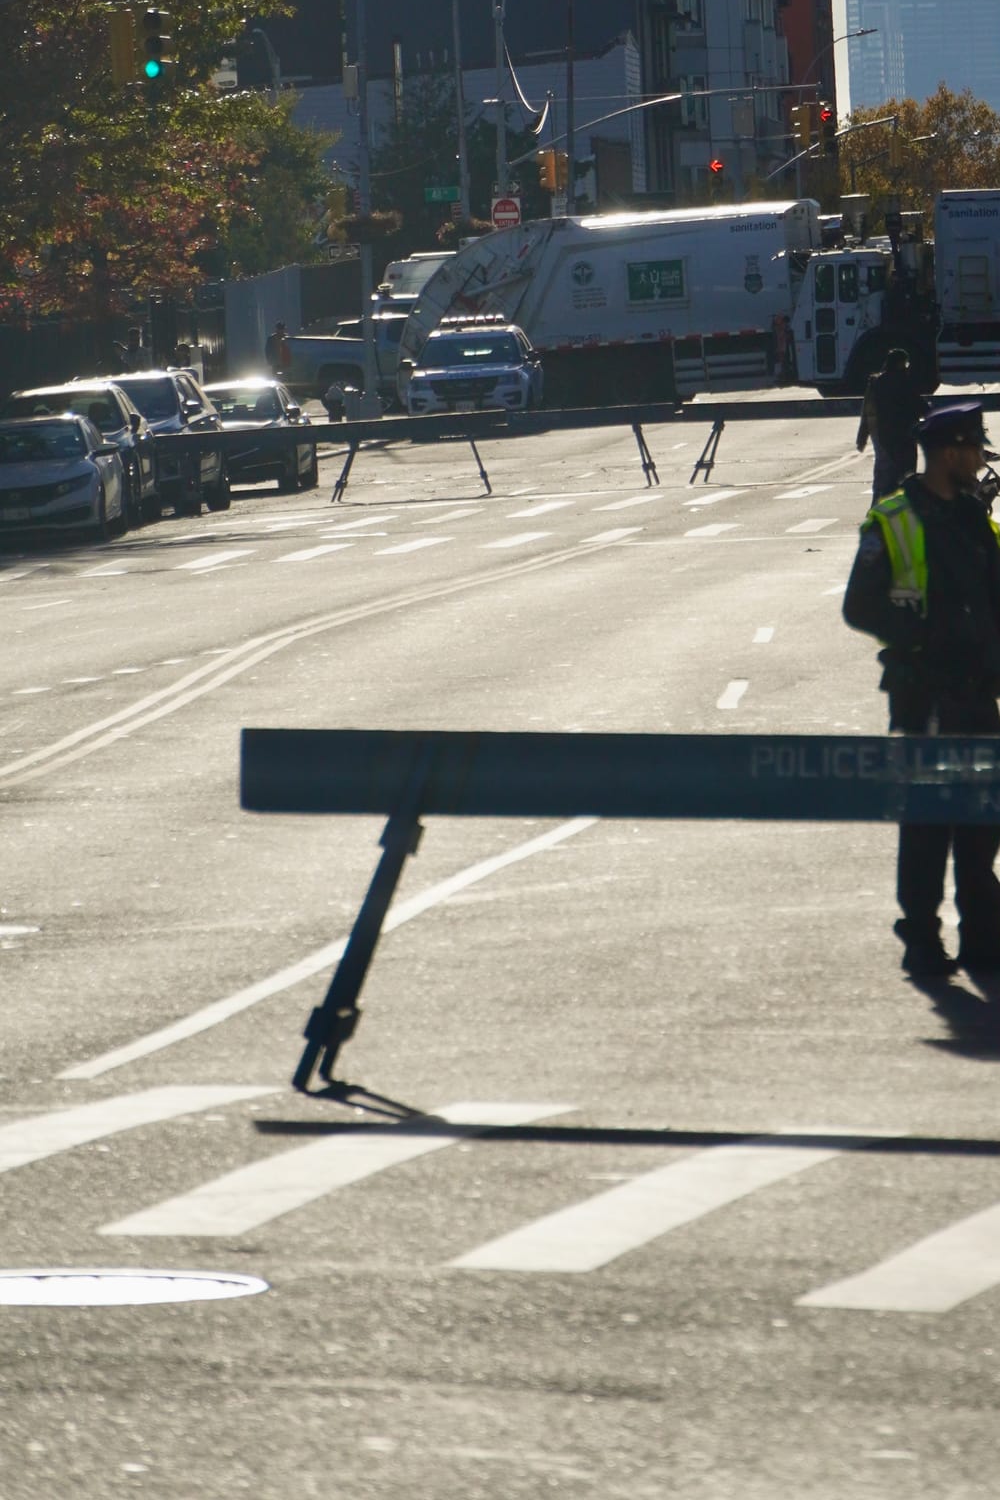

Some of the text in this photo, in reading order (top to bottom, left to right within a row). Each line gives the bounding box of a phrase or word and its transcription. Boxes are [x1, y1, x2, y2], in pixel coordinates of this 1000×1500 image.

[948, 207, 999, 219] sanitation
[729, 220, 777, 234] sanitation
[750, 748, 881, 779] POLICE
[913, 748, 996, 779] LINE
